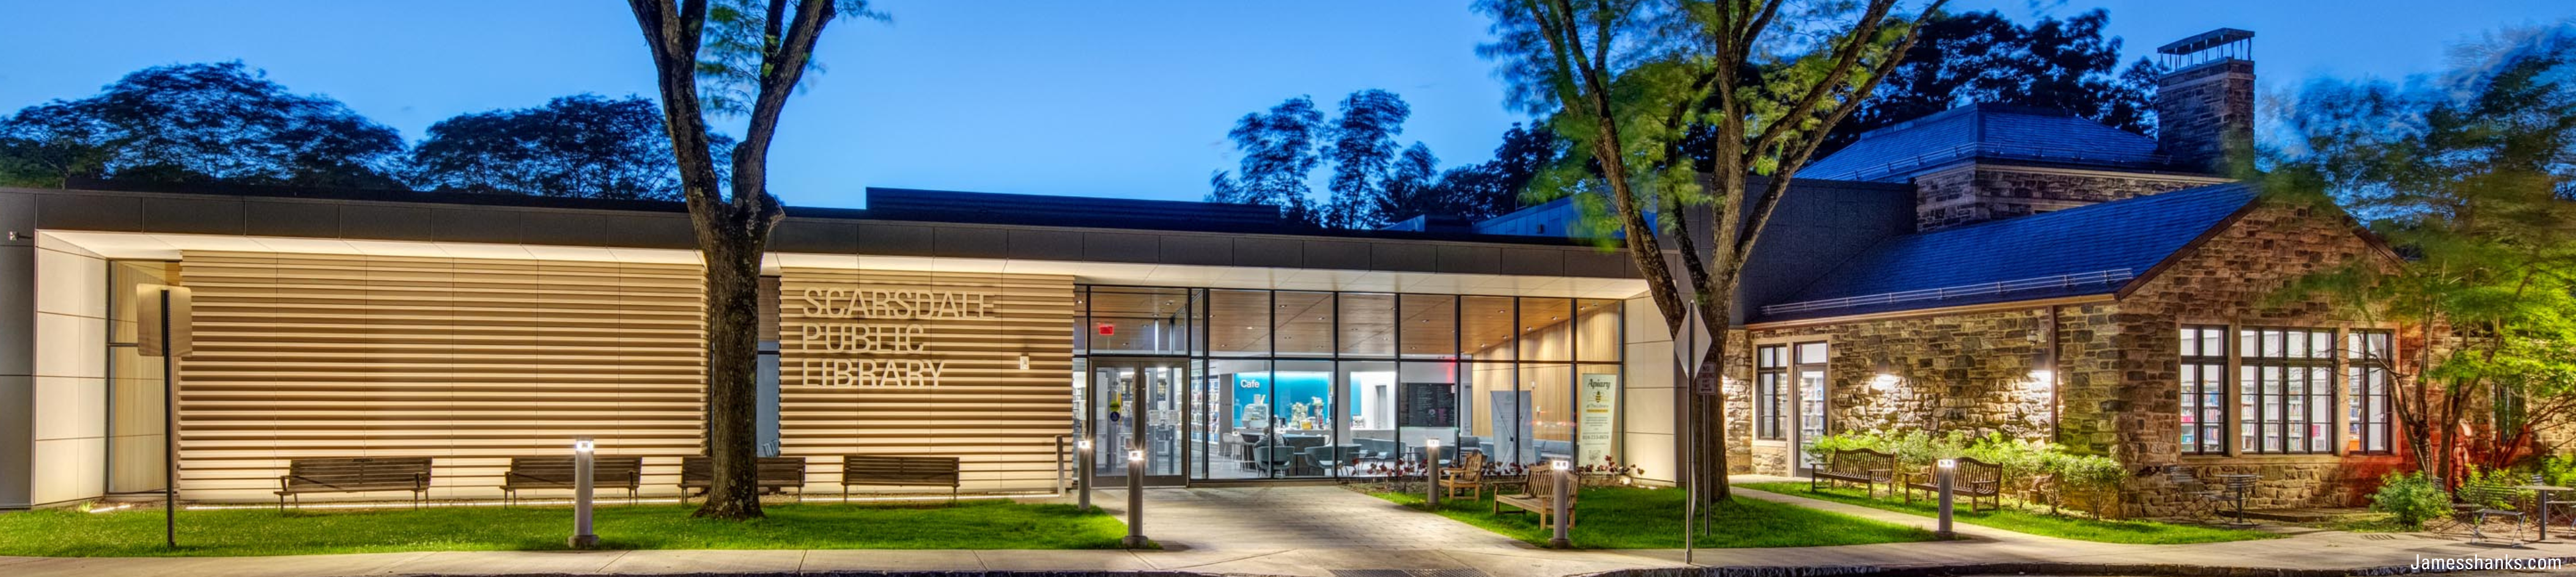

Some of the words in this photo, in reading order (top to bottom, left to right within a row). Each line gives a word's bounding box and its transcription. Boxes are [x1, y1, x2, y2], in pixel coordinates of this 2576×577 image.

[803, 287, 995, 320] SCARSDALE
[802, 323, 924, 354] PUBLIC
[802, 359, 945, 389] LIBRARY
[1240, 379, 1260, 388] Cafe
[1587, 378, 1611, 390] Apiary
